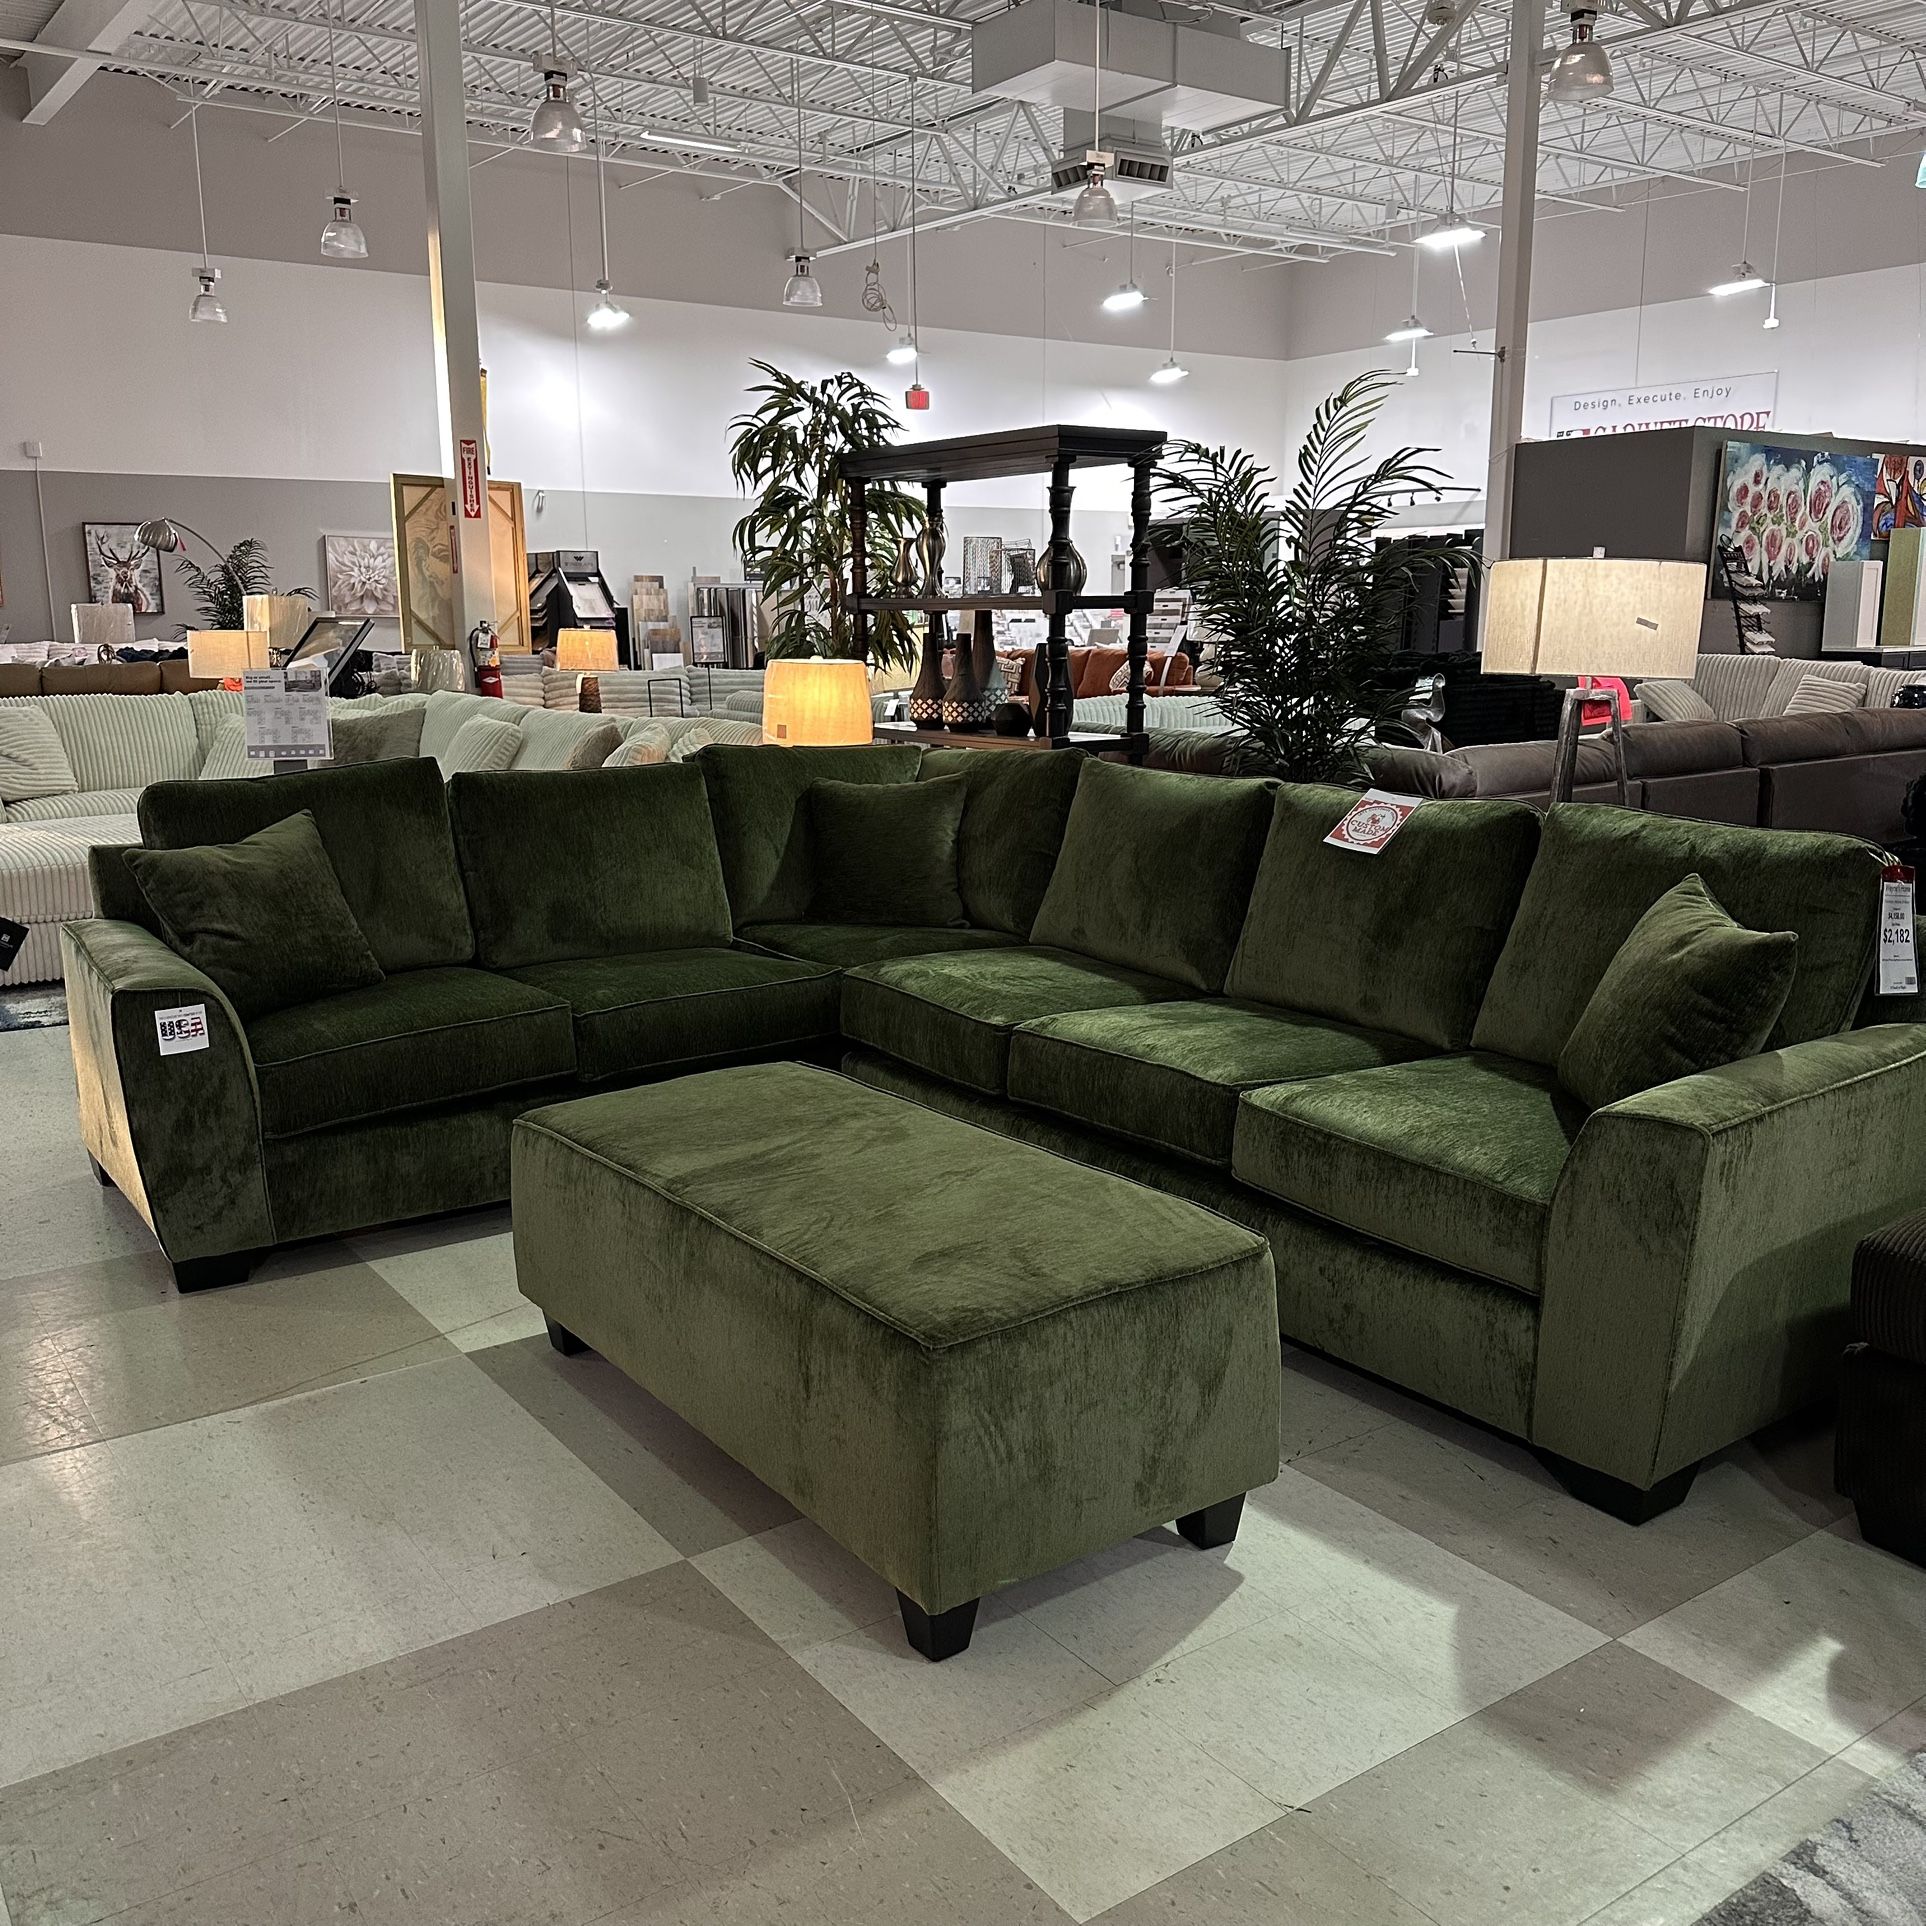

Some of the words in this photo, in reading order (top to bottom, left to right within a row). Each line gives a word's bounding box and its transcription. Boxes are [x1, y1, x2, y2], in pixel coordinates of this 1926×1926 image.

[1693, 386, 1732, 399] Enjoy
[462, 446, 475, 455] FIRE
[467, 457, 475, 512] EXTINGUISHER
[1350, 820, 1390, 831] CUSTOM
[1352, 826, 1379, 836] MADE
[1883, 928, 1910, 945] $2,182
[160, 1016, 205, 1040] USA
